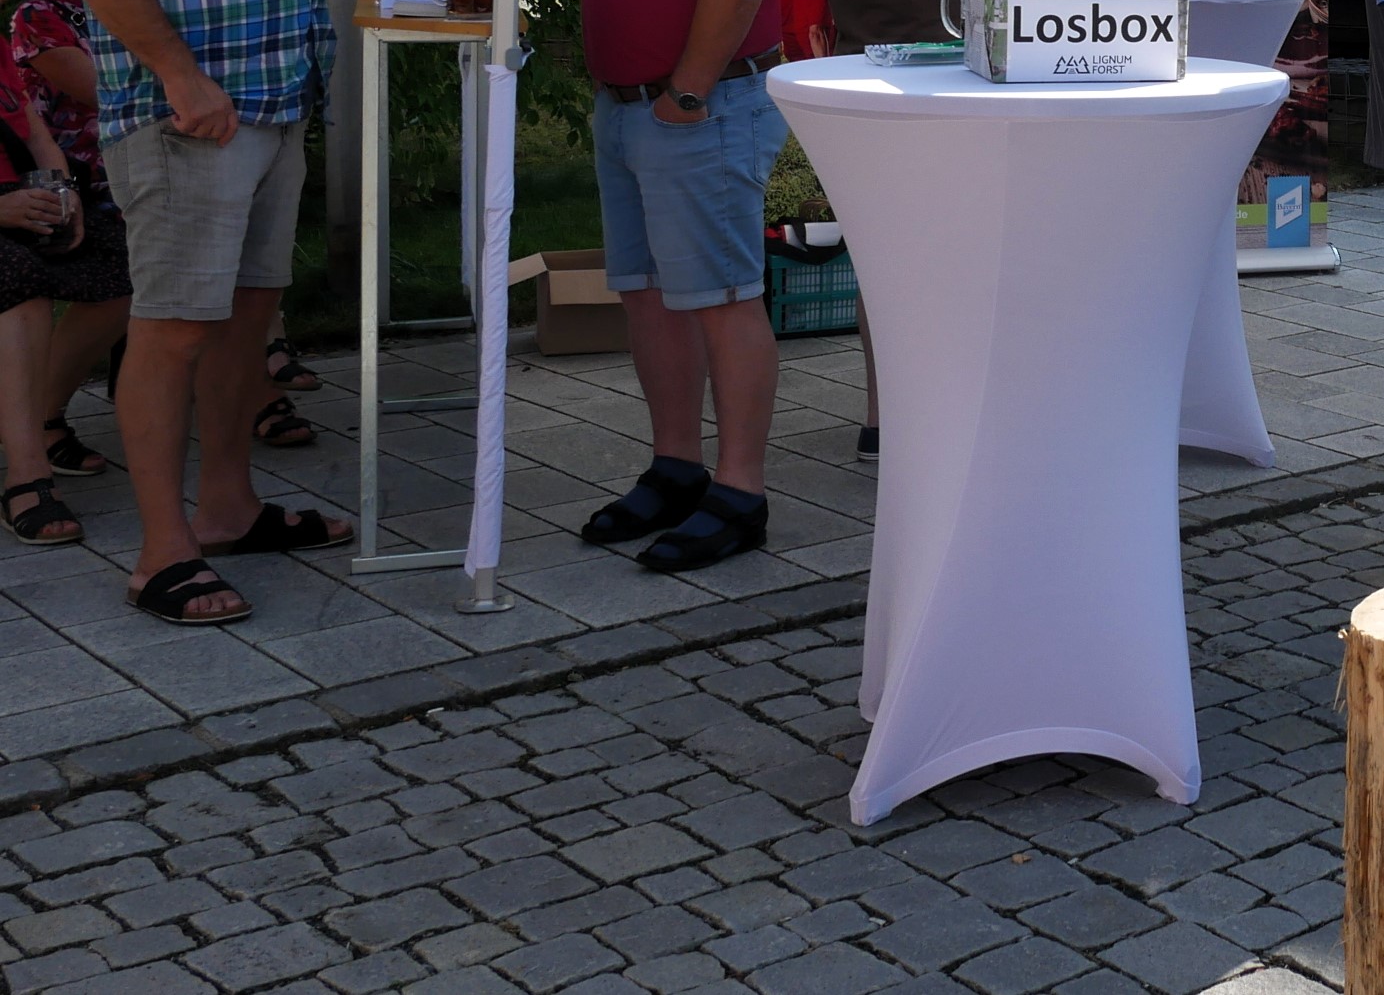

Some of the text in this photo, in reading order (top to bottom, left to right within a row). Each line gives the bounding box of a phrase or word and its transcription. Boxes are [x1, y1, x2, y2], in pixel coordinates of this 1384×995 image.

[1012, 3, 1174, 43] Losbox
[1092, 55, 1132, 65] LIGNUM
[1092, 65, 1126, 75] FORST
